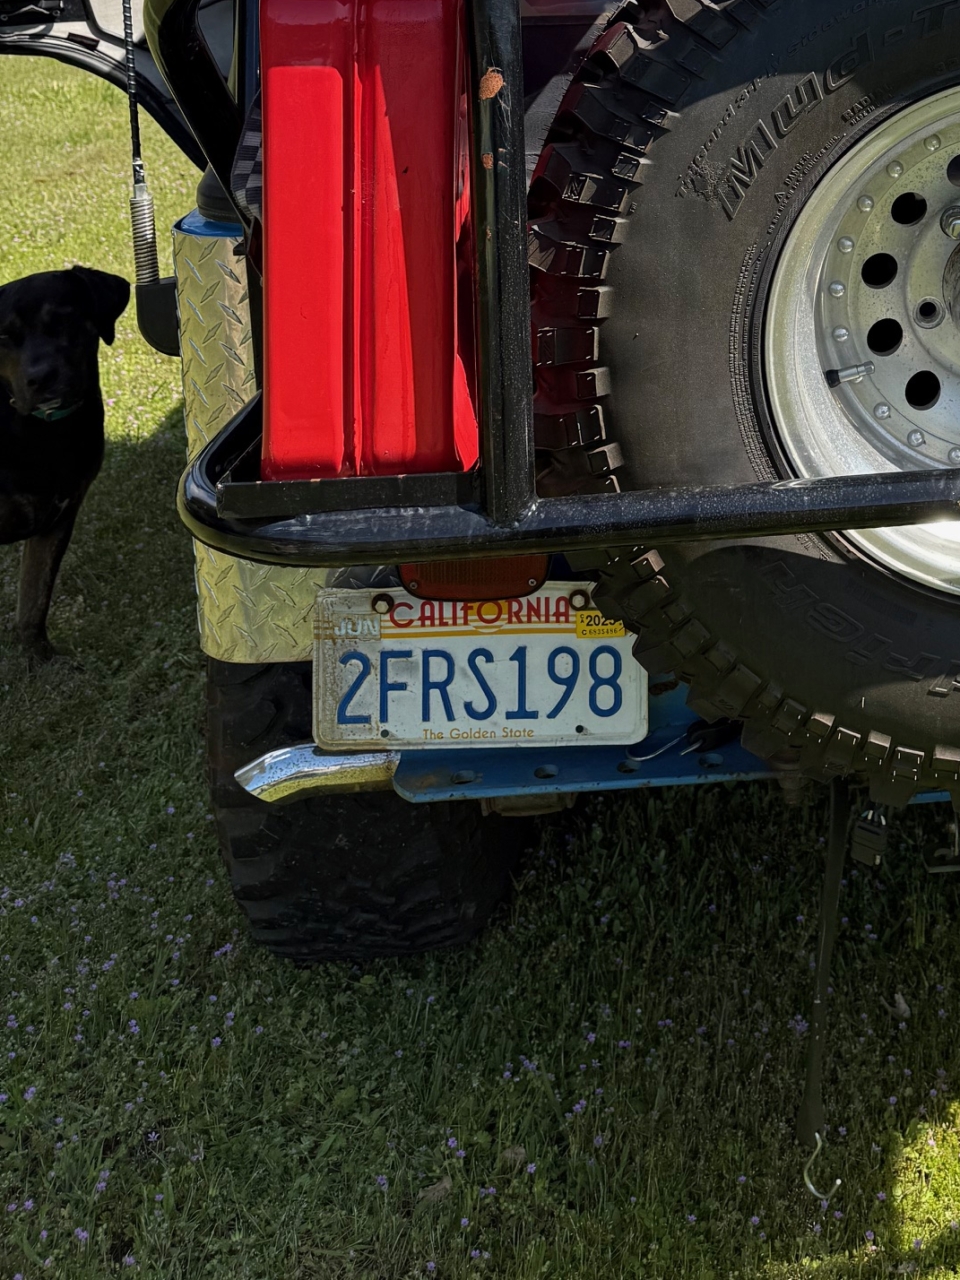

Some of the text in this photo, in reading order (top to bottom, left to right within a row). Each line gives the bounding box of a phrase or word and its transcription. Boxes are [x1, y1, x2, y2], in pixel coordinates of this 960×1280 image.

[389, 596, 571, 628] CALIFORNIA
[334, 616, 380, 636] JUN
[336, 645, 623, 725] 2FRS198
[423, 727, 535, 740] The Golden State
